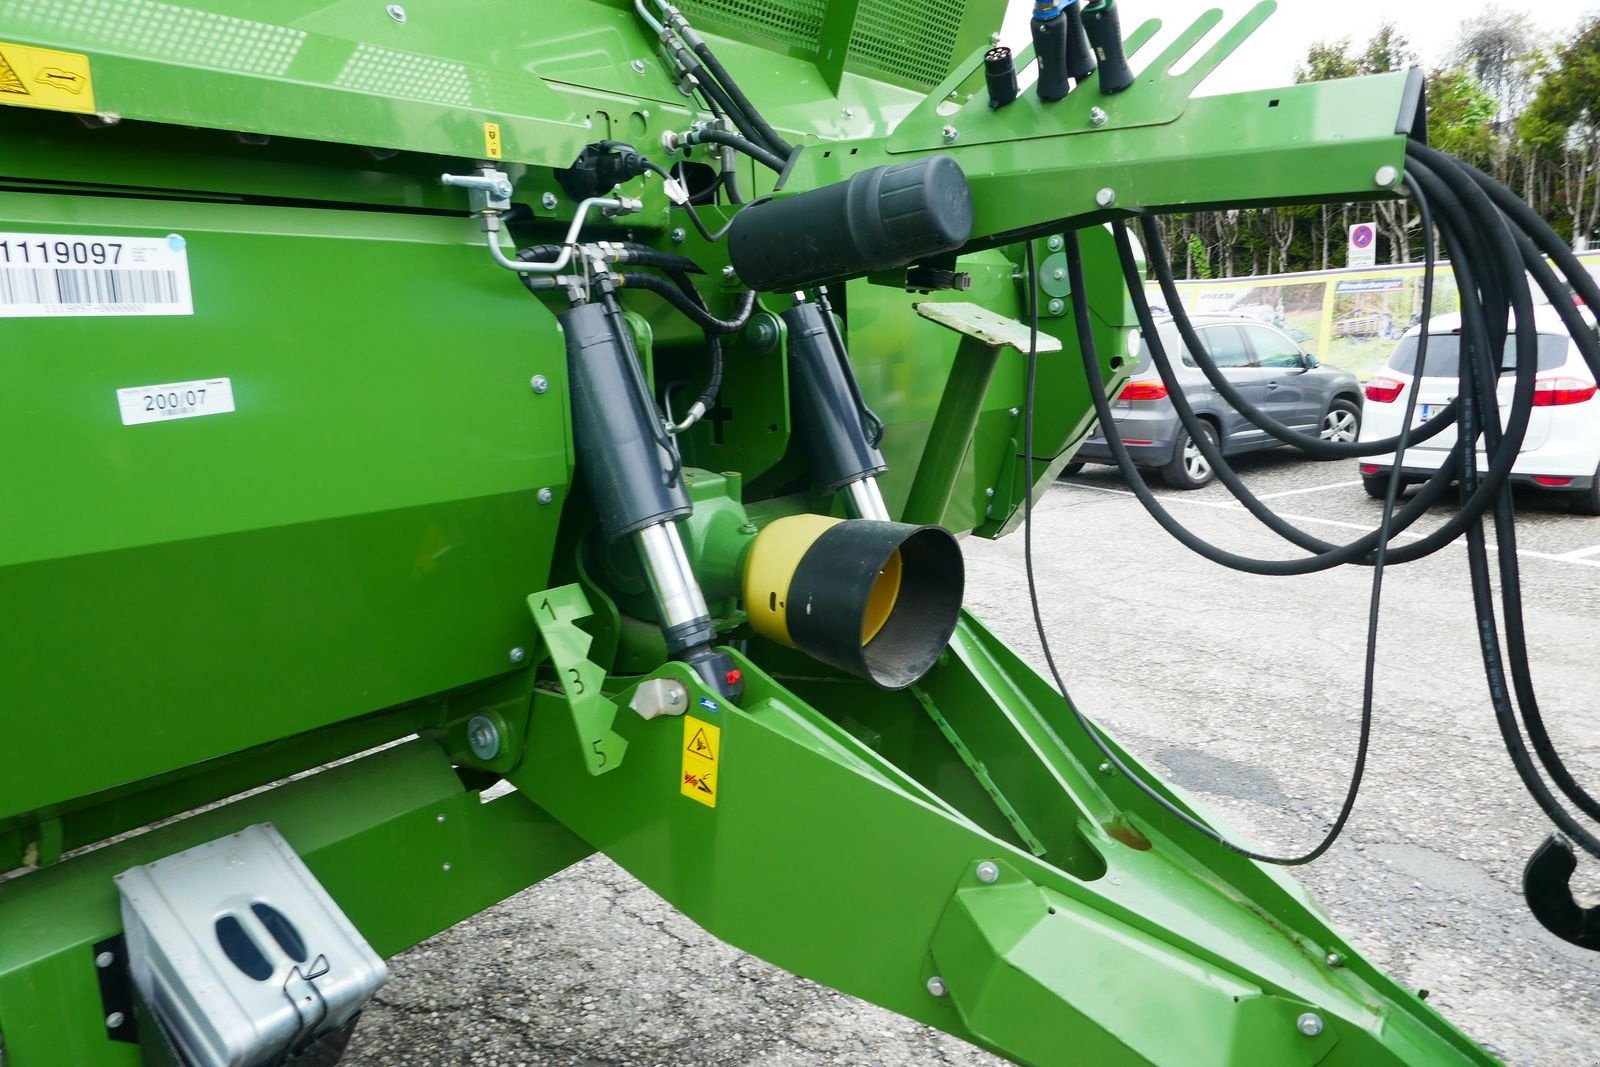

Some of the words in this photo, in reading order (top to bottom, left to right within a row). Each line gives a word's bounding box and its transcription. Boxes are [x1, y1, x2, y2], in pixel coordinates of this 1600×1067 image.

[0, 240, 123, 264] 1119097
[144, 389, 206, 412] 200/07
[541, 597, 557, 621] 1
[568, 668, 584, 695] 3
[591, 739, 607, 768] 5
